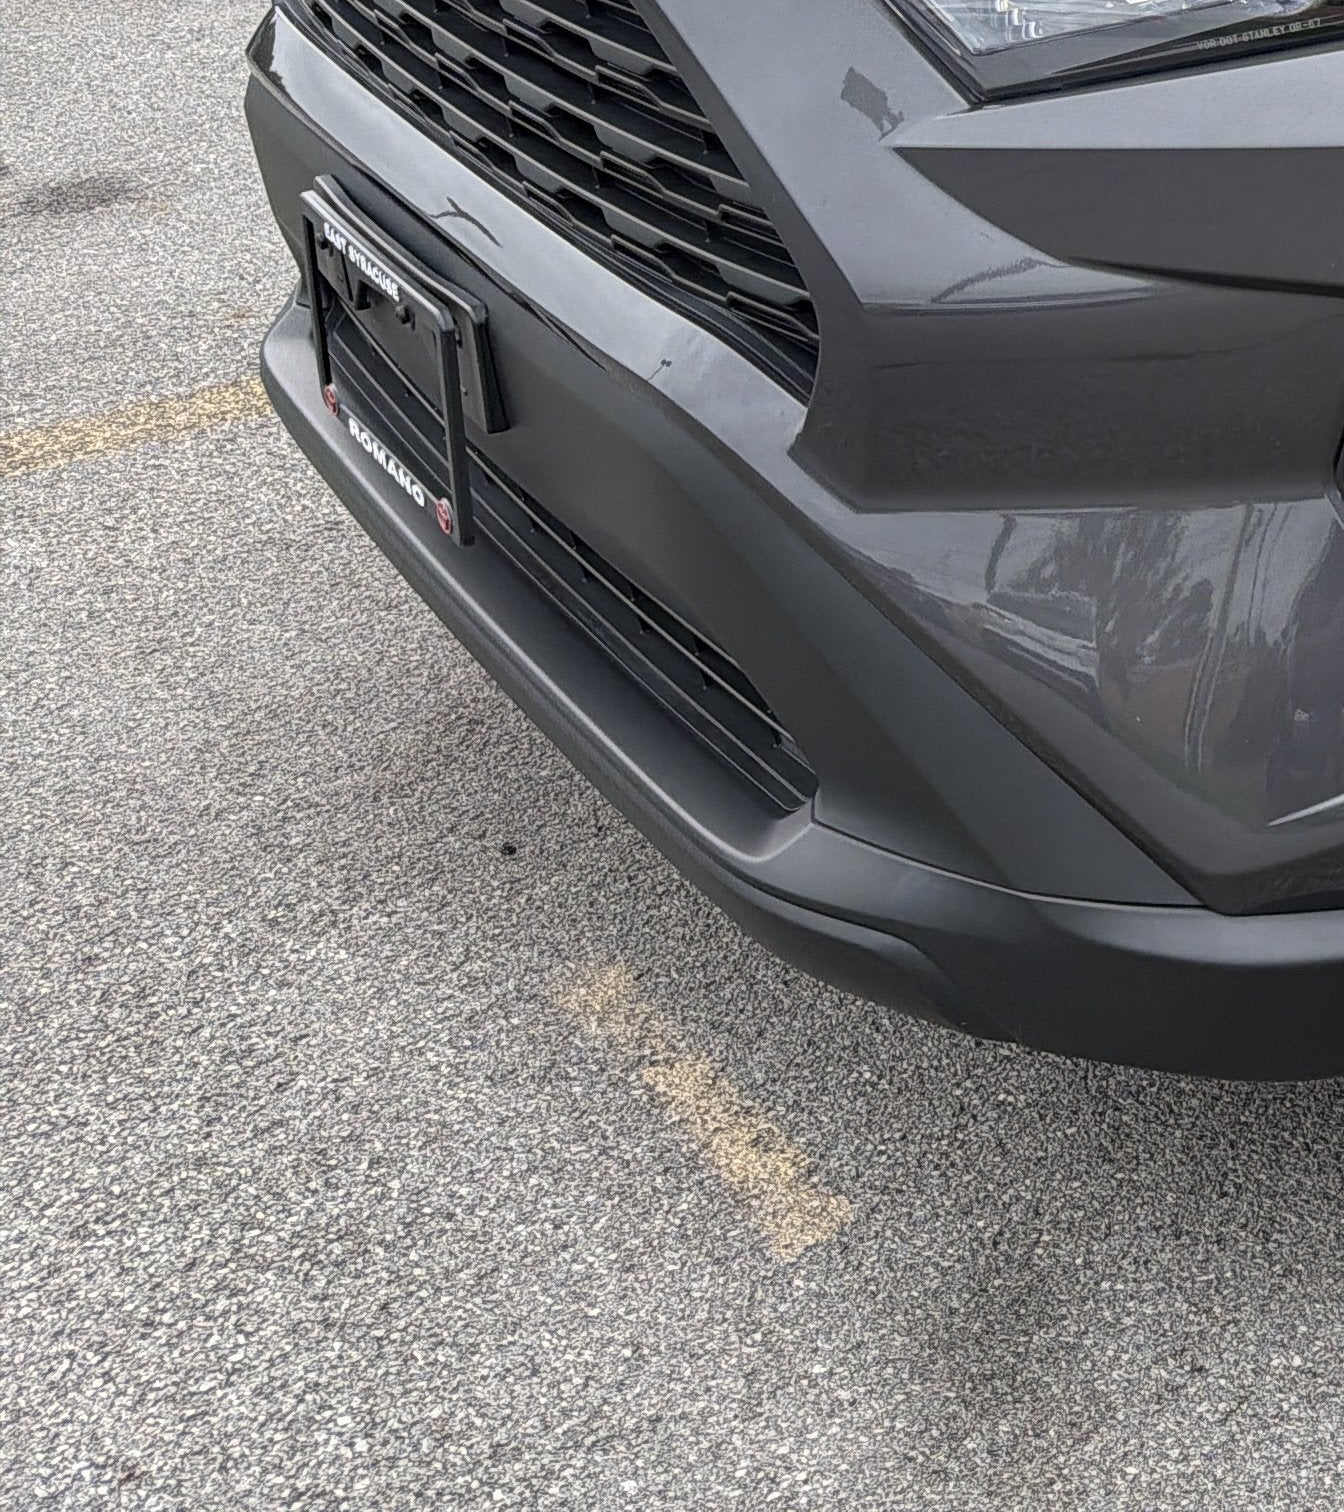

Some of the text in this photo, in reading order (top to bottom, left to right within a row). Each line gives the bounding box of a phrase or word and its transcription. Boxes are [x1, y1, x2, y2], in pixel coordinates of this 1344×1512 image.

[1242, 24, 1286, 42] STANLEY
[324, 222, 400, 303] EAST SYRACUSE
[348, 417, 426, 508] ROMANO
